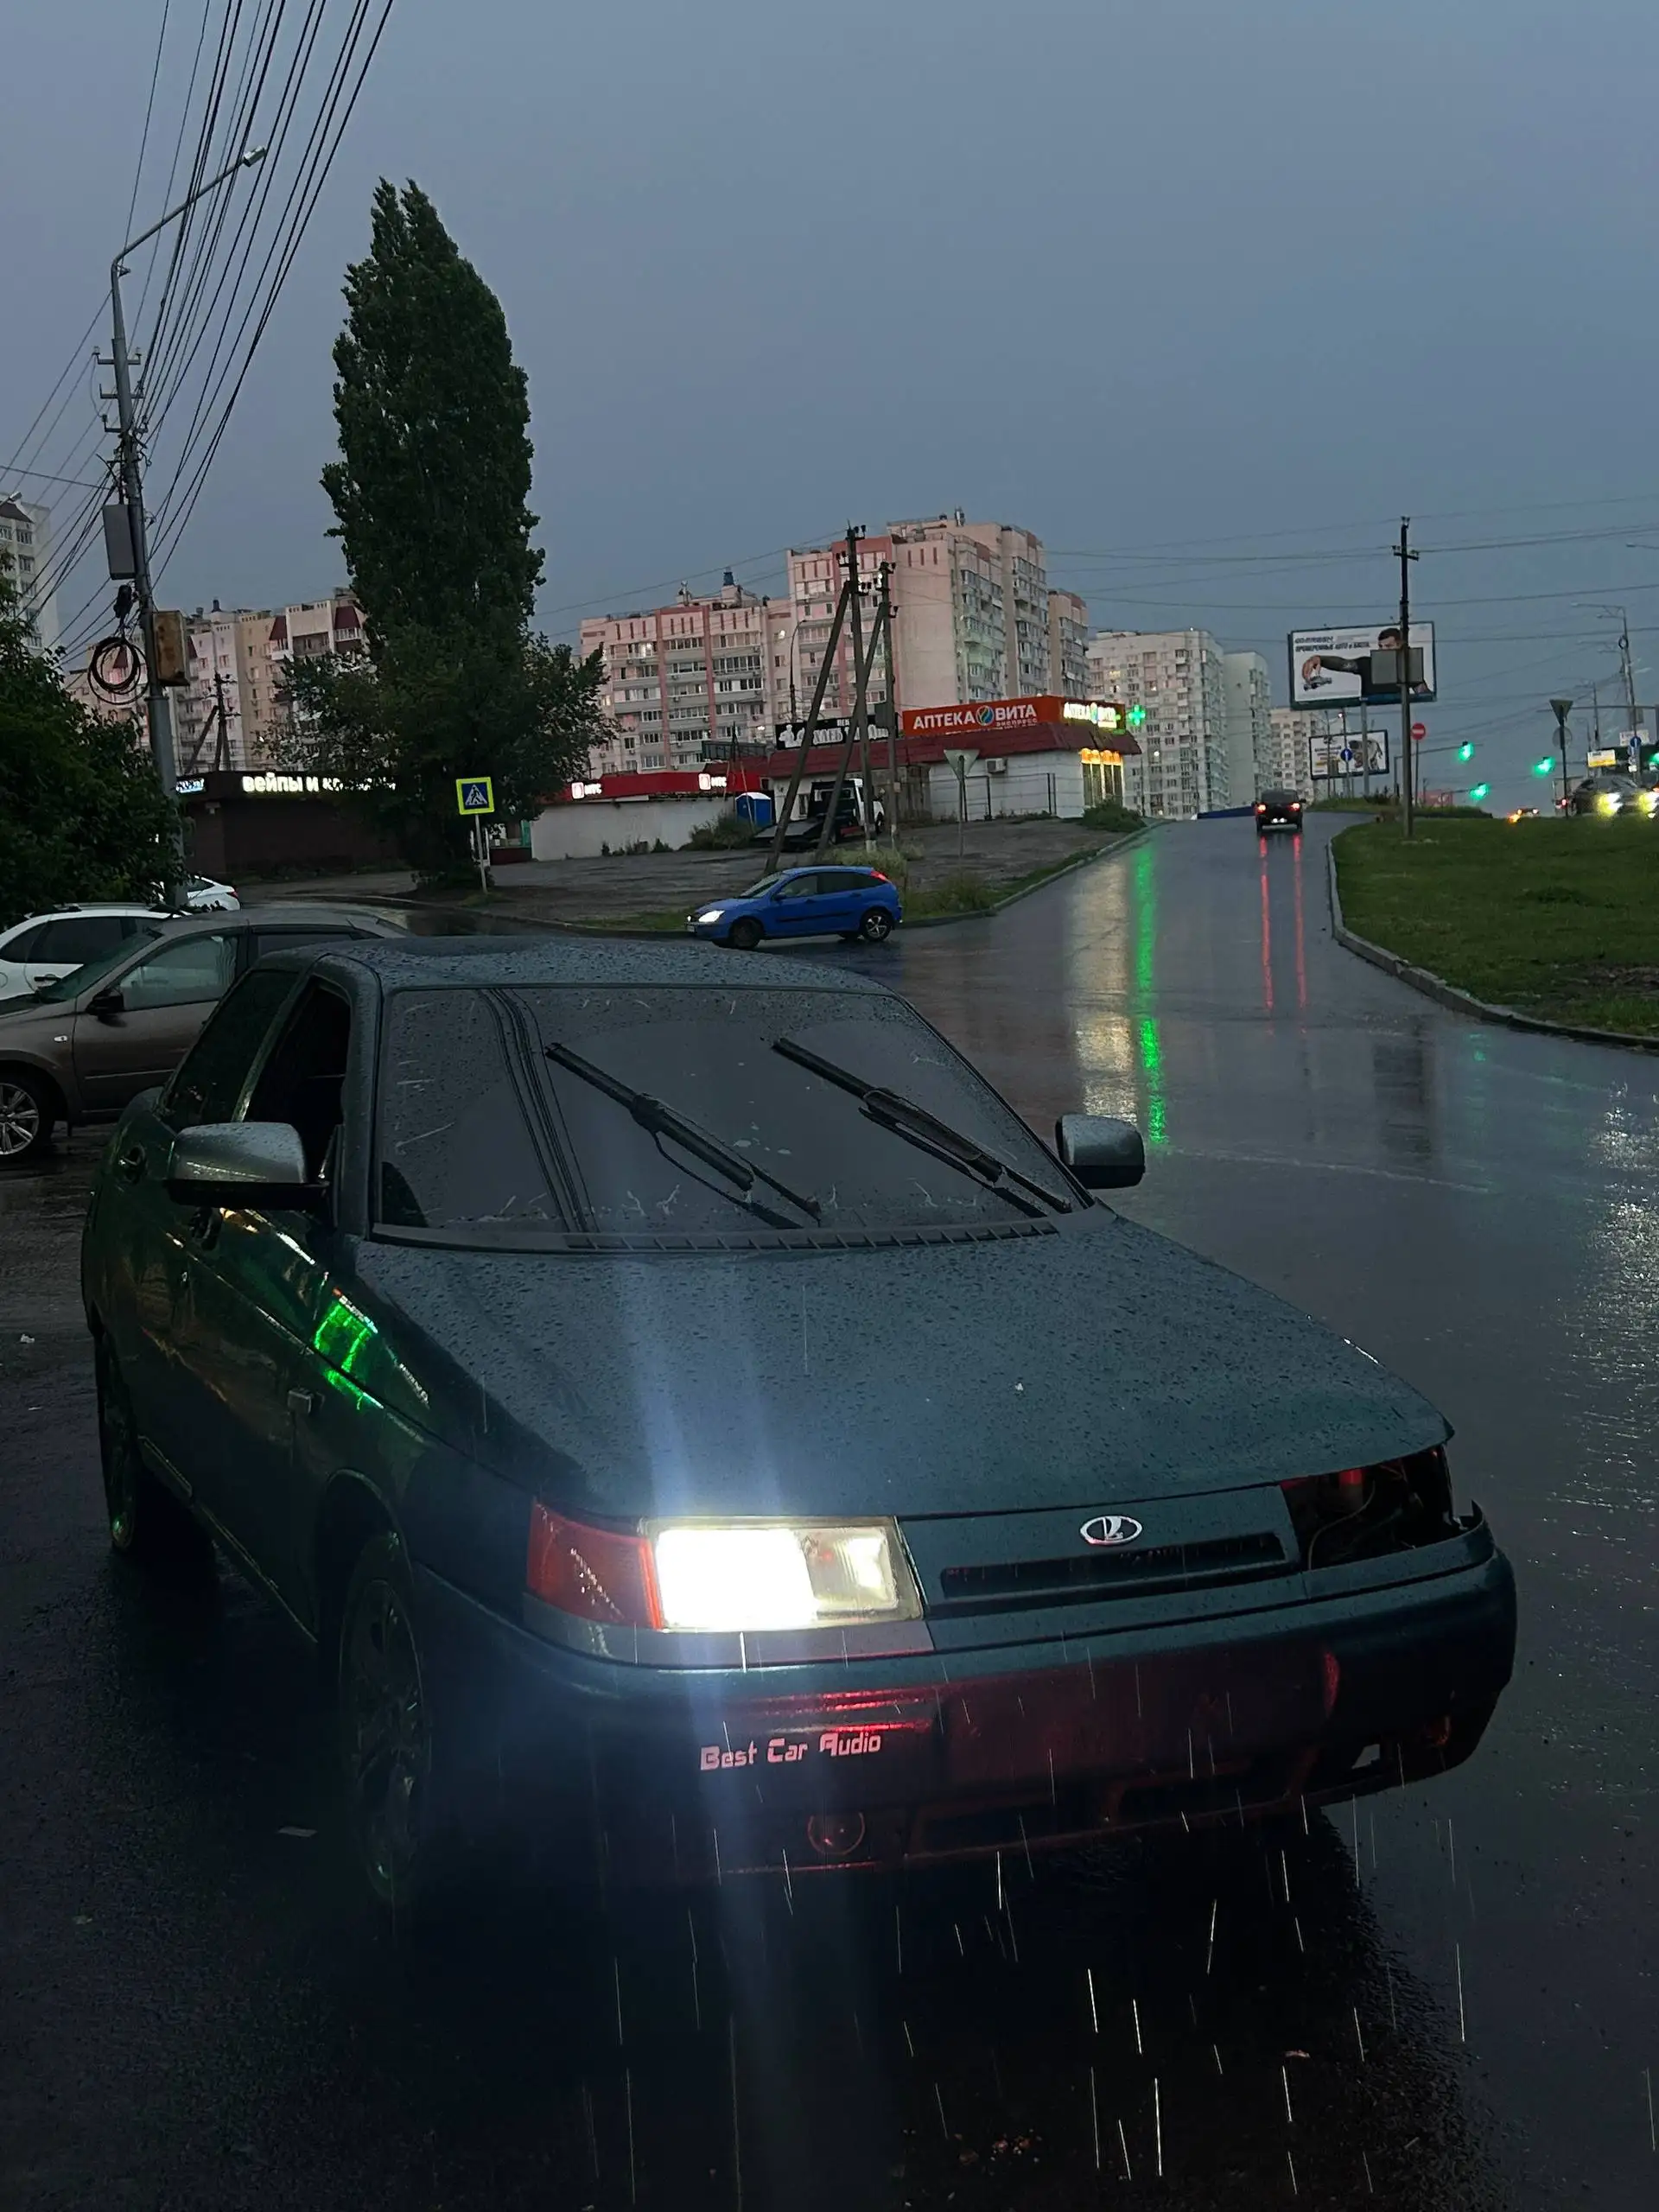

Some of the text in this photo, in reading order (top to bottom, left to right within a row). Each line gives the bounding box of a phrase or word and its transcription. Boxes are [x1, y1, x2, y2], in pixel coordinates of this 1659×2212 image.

[913, 711, 976, 730] АПТЕКА
[995, 704, 1037, 721] ВИТА
[700, 1732, 881, 1770] Best Car Audio
